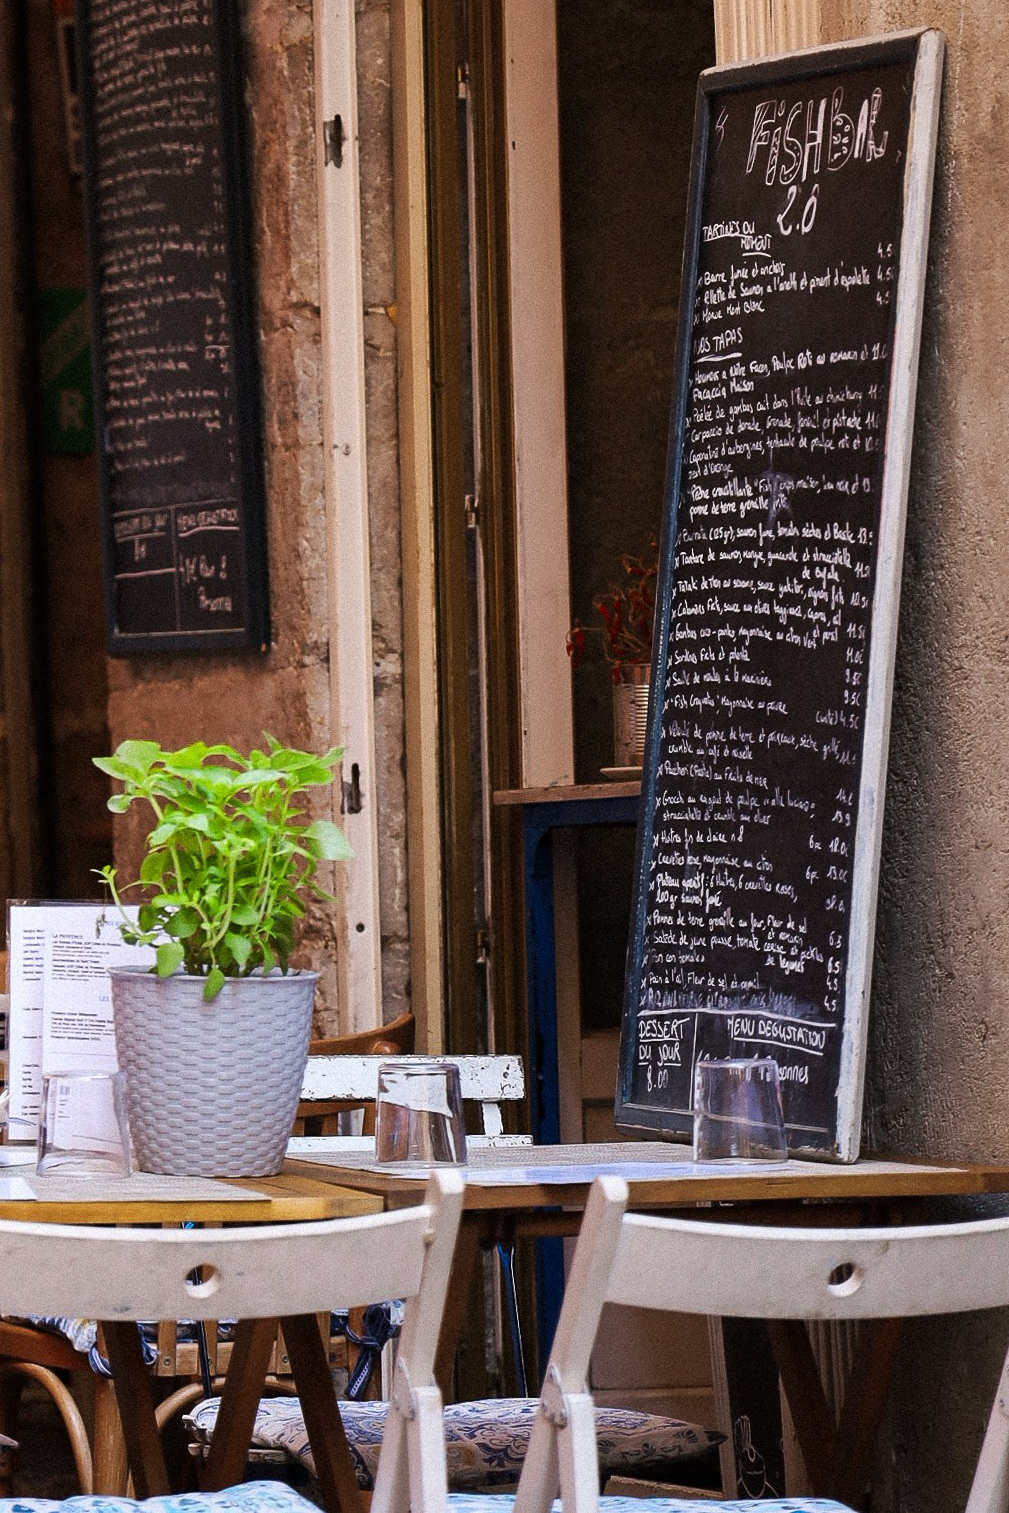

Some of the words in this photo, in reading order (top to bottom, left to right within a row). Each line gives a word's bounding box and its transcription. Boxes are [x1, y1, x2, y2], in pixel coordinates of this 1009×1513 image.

[777, 184, 819, 236] 2.0
[713, 328, 743, 352] TAPAS
[639, 1018, 690, 1039] DESSERT
[728, 1015, 755, 1038] MENU
[639, 1044, 652, 1060] DU
